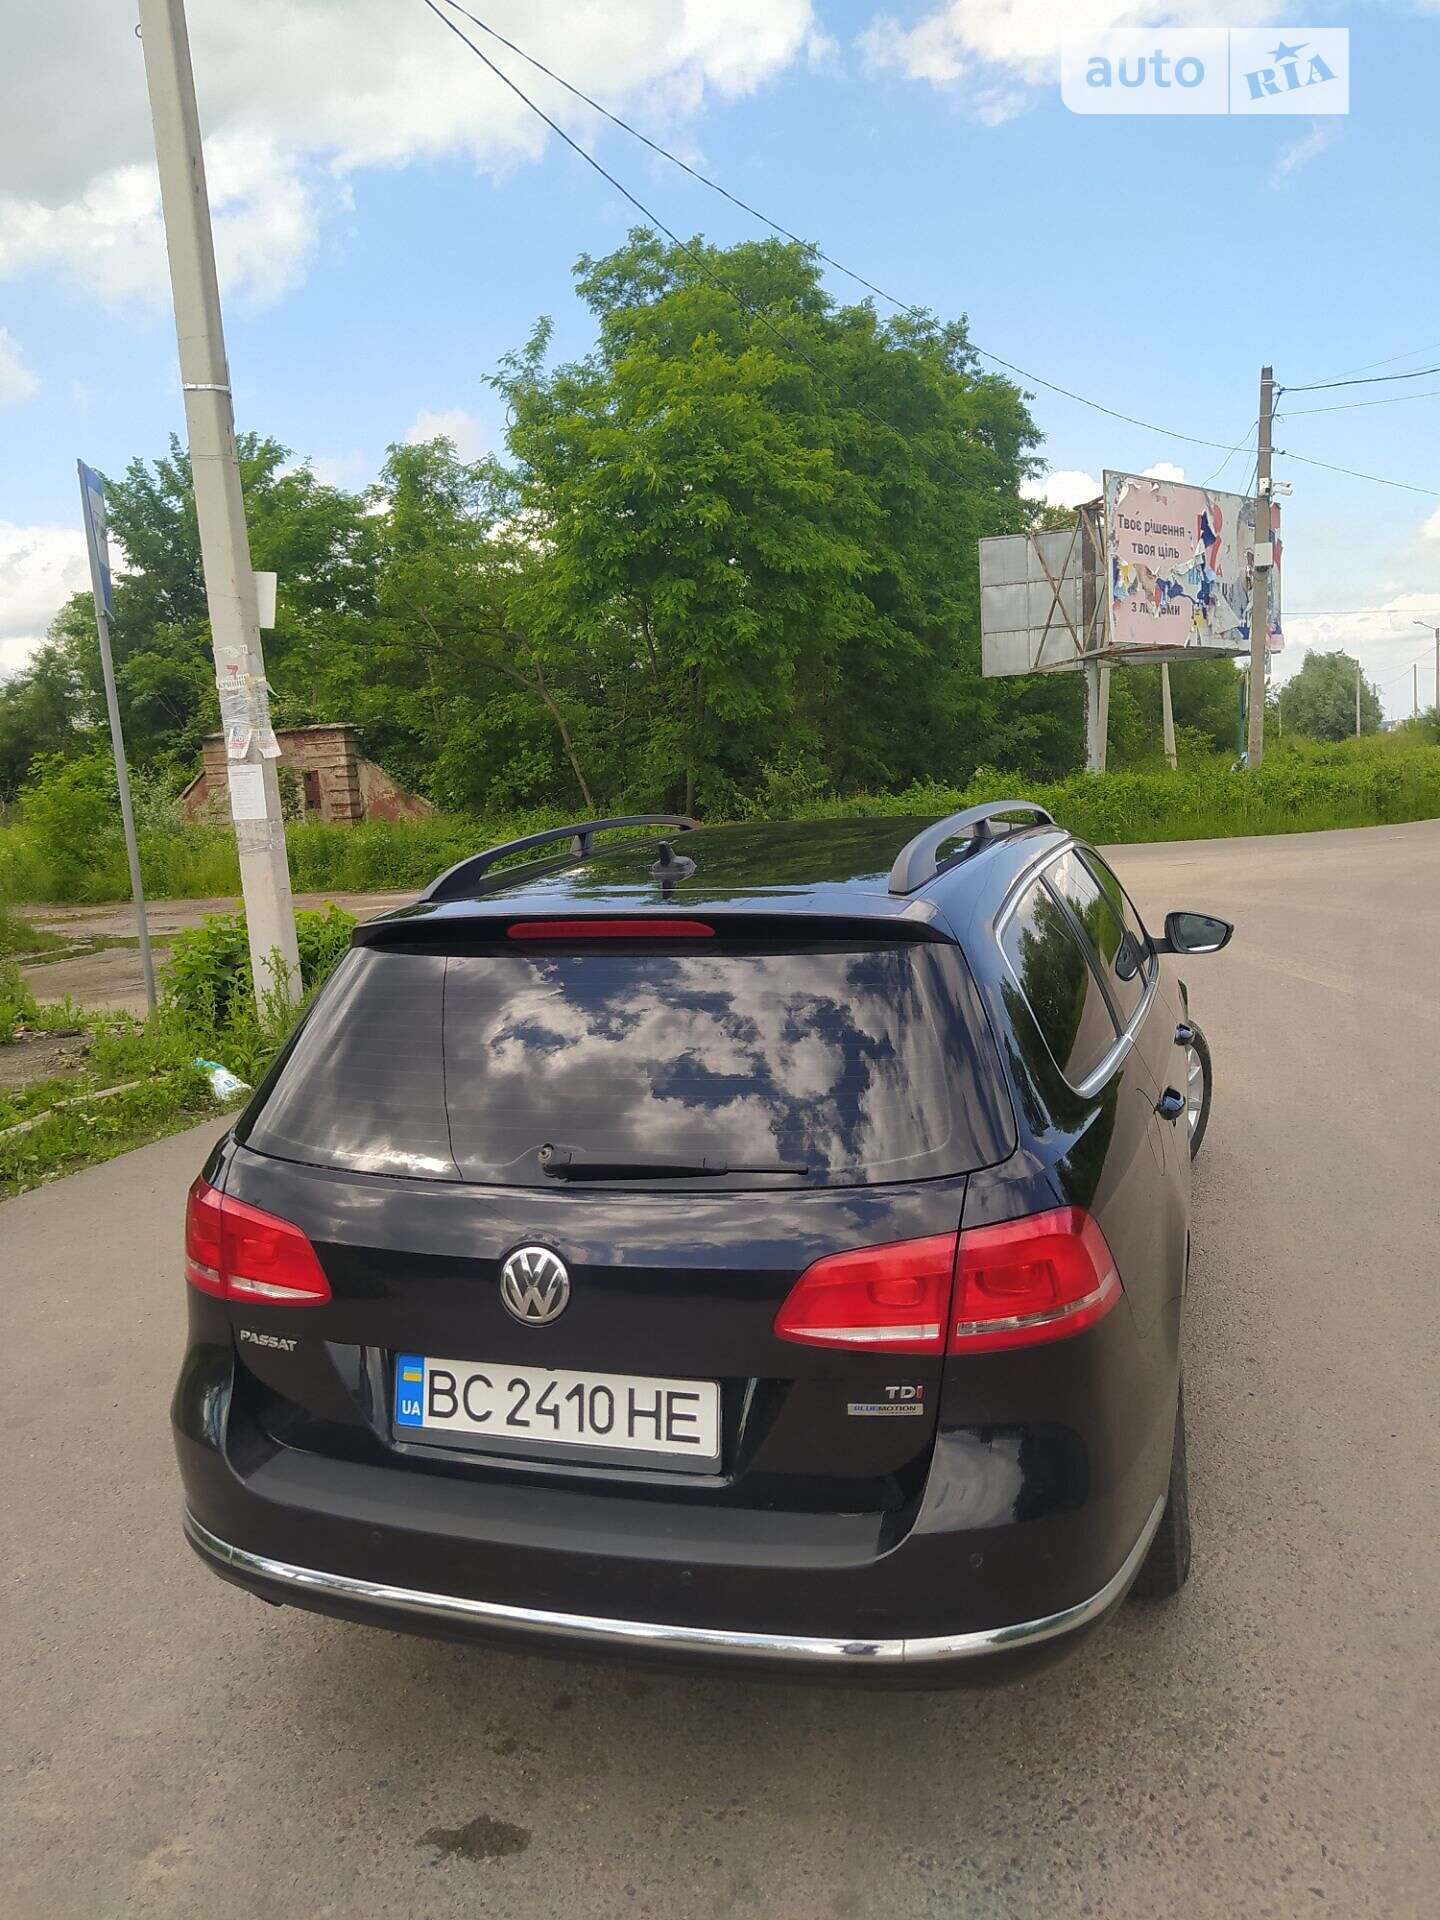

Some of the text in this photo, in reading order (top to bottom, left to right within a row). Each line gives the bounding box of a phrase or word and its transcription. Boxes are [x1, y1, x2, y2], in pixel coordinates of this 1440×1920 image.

[1117, 514, 1142, 531] Твоє
[1144, 518, 1185, 537] рішення
[1132, 543, 1180, 559] твоя ціль
[1139, 602, 1180, 617] льми
[240, 1329, 298, 1351] PASSAT
[401, 1399, 421, 1416] UA
[428, 1369, 701, 1444] BC 2410 HE
